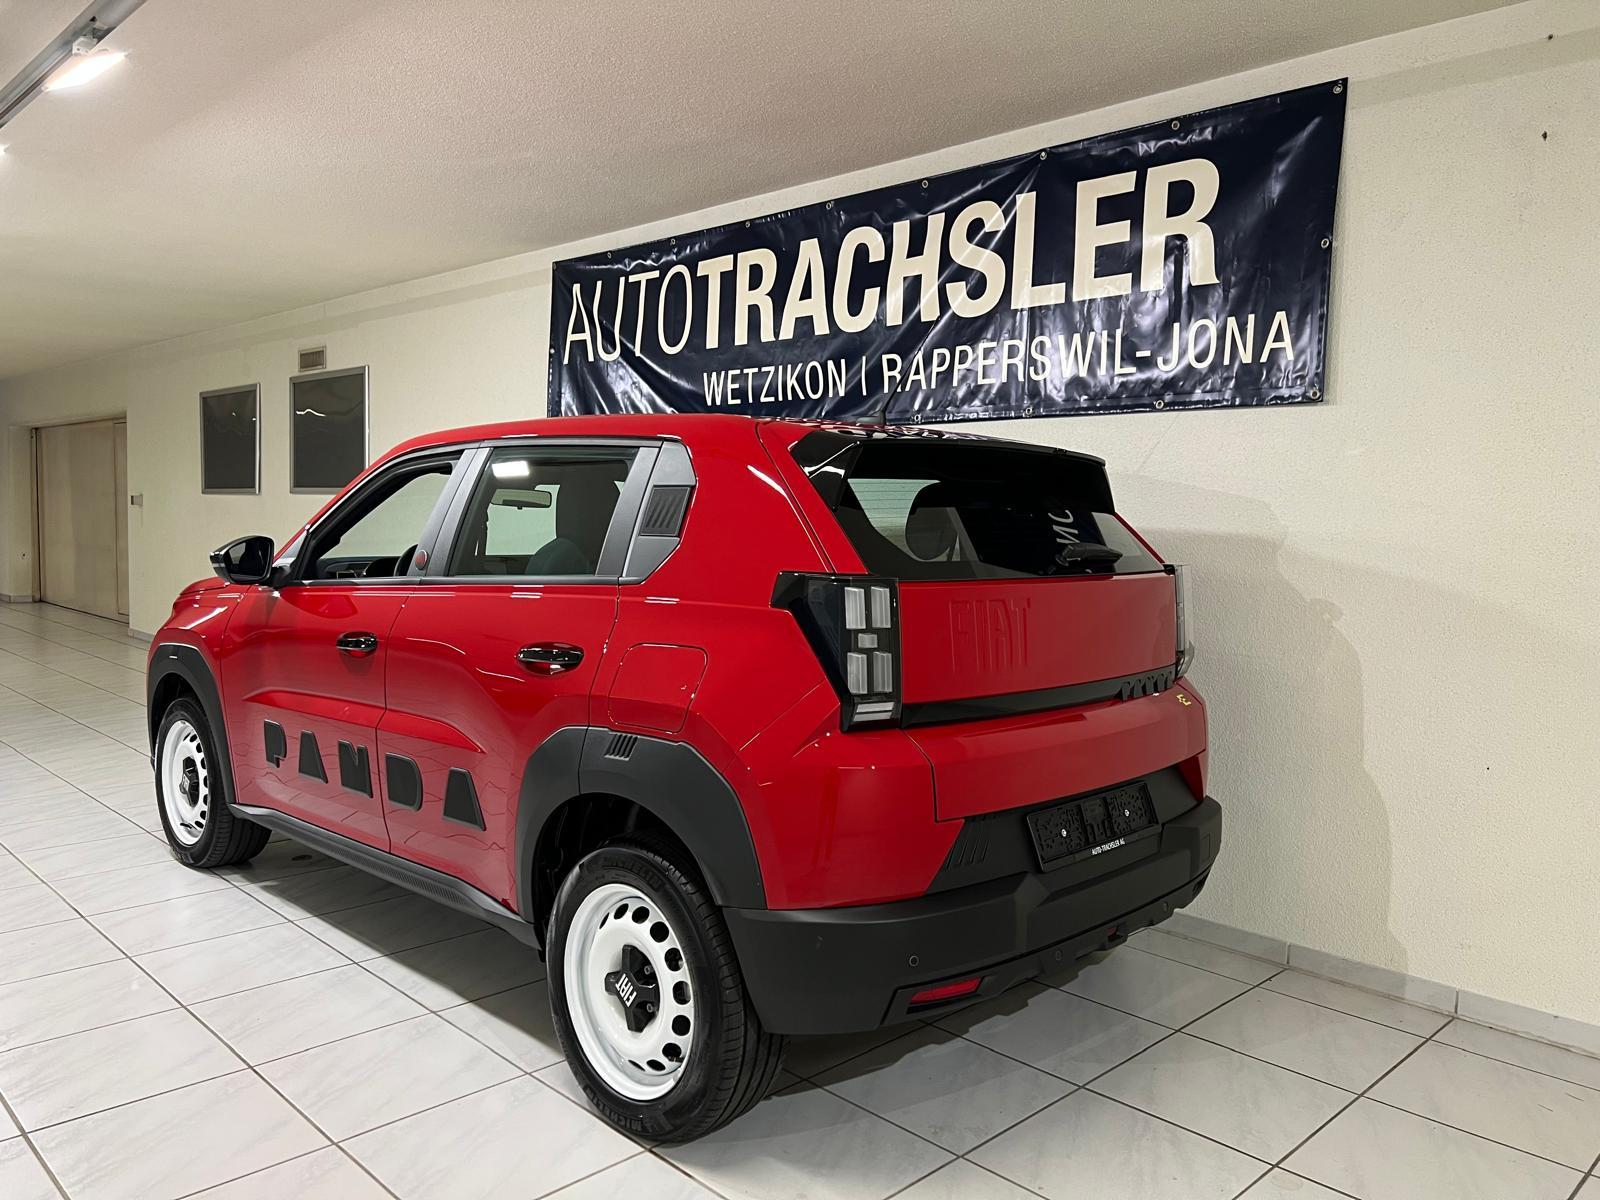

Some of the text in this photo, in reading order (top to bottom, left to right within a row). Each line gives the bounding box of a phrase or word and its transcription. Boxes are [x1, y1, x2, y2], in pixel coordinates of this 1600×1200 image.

[703, 357, 847, 407] WETZIKON
[882, 310, 1295, 395] RAPPERSWIL-JONA
[947, 598, 1031, 674] FIAT
[263, 719, 487, 832] PANDA
[615, 973, 637, 1008] FIAT
